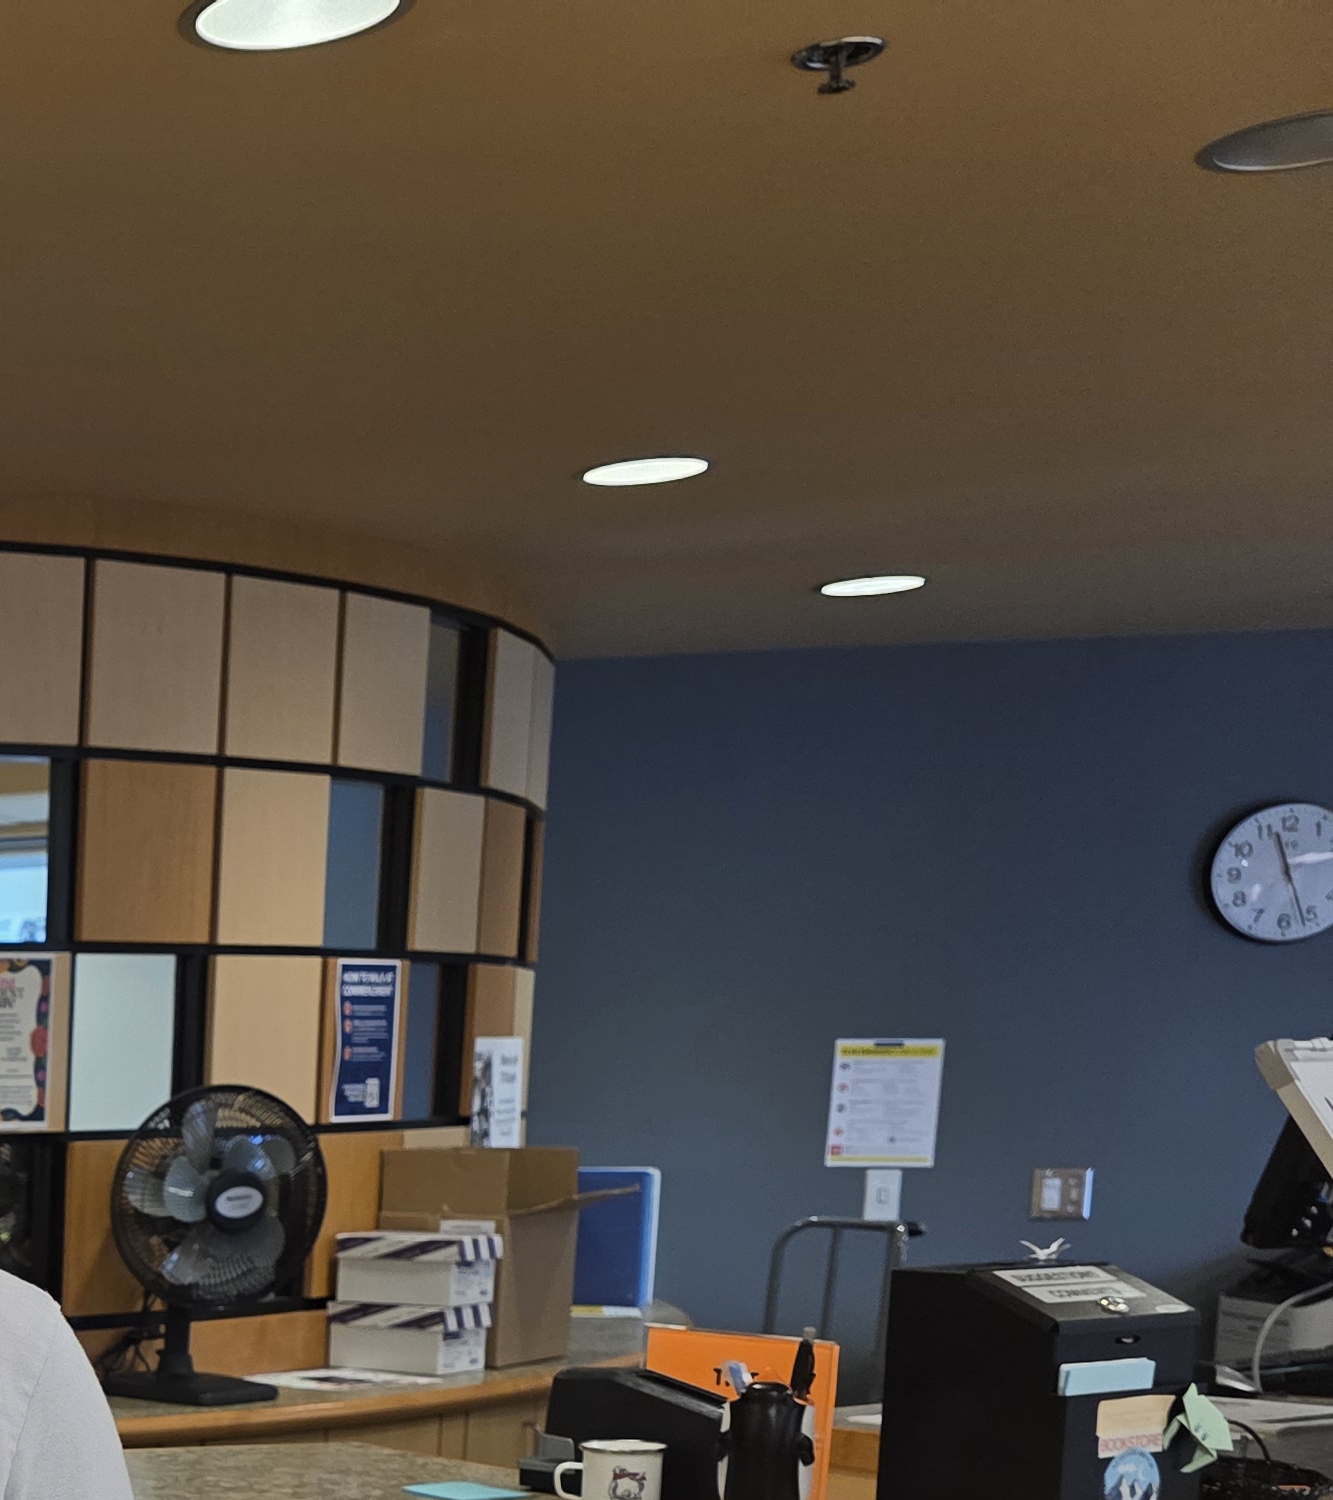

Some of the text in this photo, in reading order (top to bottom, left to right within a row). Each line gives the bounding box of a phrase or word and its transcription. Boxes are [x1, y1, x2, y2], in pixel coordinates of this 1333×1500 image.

[1282, 814, 1300, 833] 12
[1234, 840, 1254, 859] 10
[1226, 866, 1242, 884] 9
